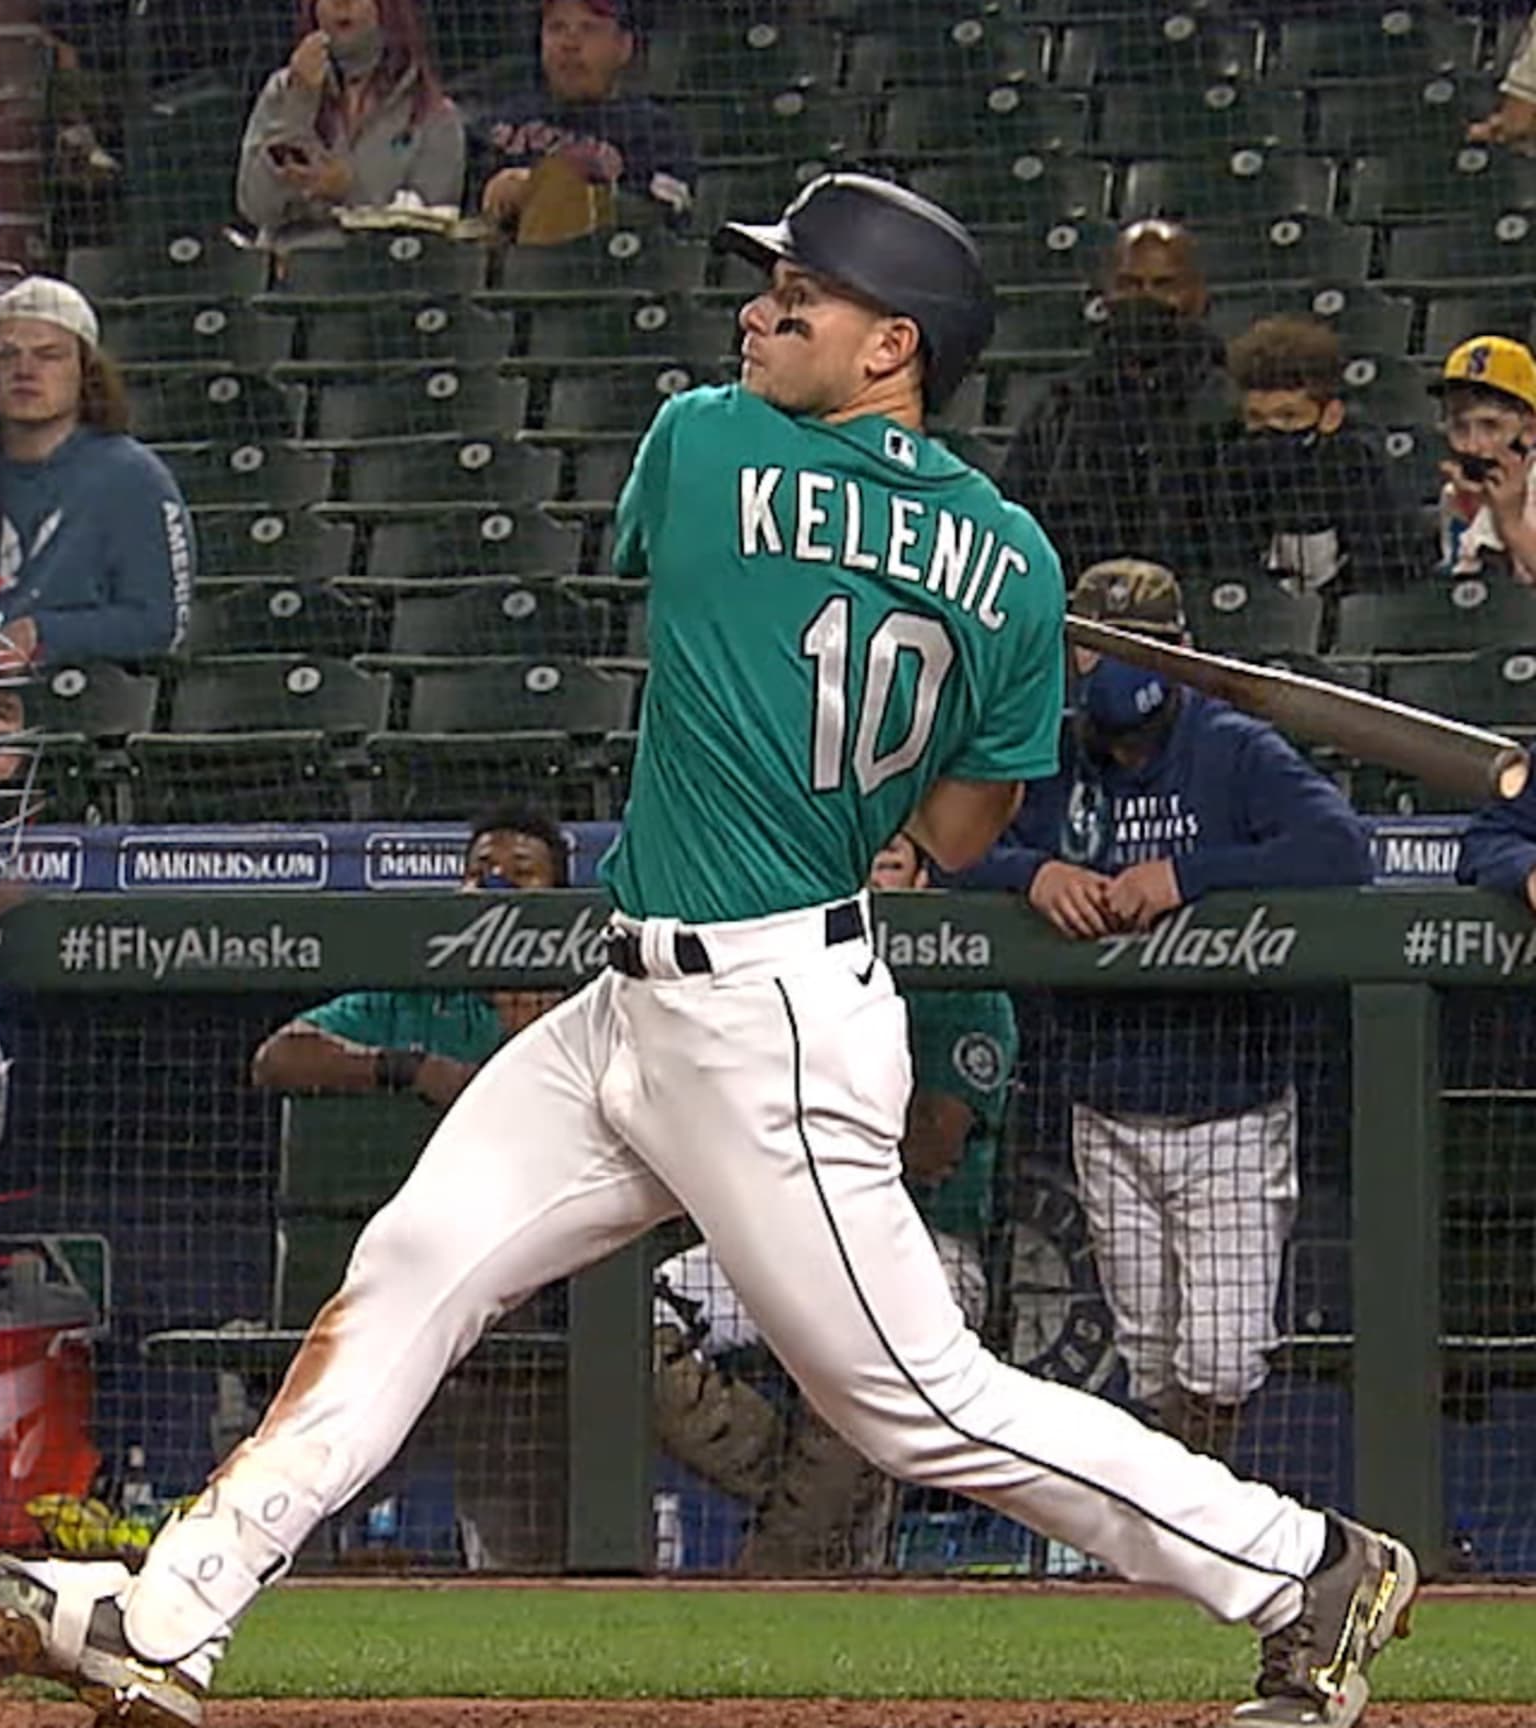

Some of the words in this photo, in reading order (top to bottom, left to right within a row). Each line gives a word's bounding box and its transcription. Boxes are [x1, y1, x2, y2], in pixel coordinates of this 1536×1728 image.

[739, 470, 1028, 631] KELENIC
[802, 597, 956, 795] 10
[134, 852, 315, 880] MARINERS.COM
[59, 924, 322, 979] #iFlyAlaska
